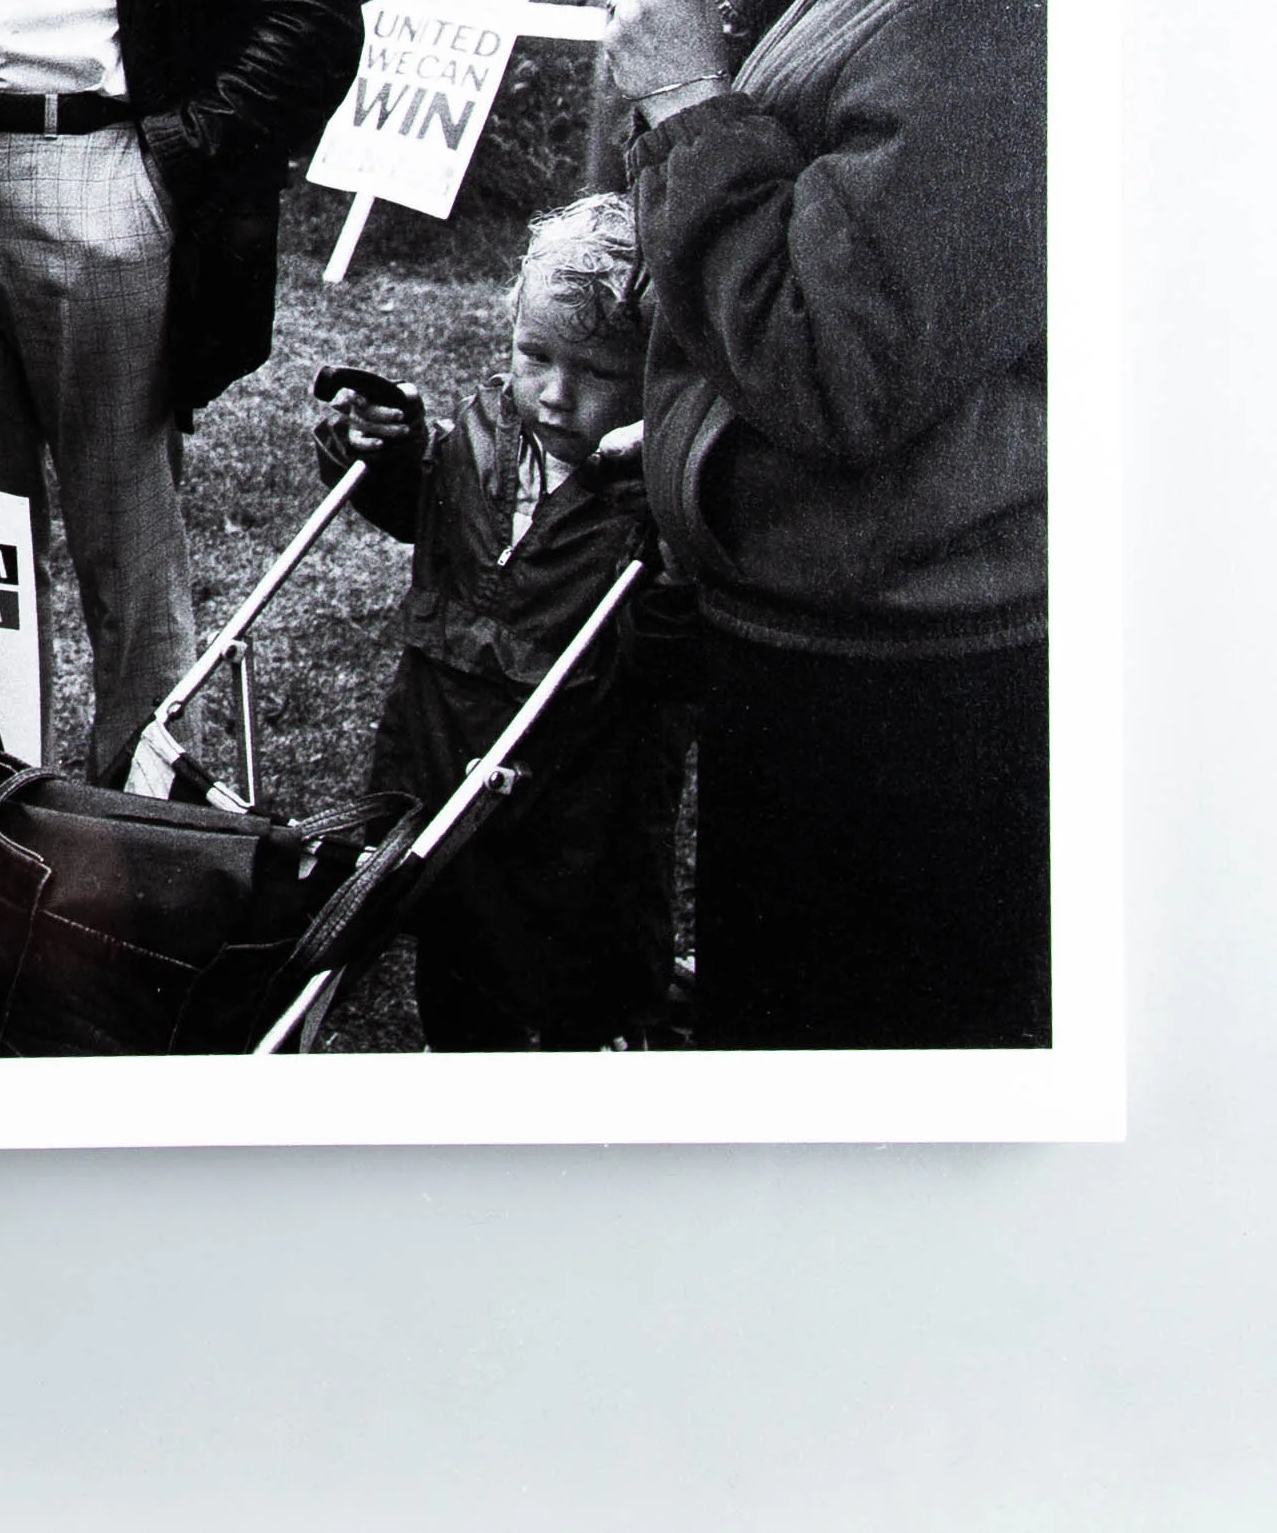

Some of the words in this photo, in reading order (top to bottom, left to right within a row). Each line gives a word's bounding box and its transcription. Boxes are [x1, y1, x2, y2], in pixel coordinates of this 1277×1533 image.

[373, 10, 502, 57] UNITED
[365, 44, 414, 76] WE
[416, 54, 490, 92] CAN
[353, 77, 476, 151] WIN
